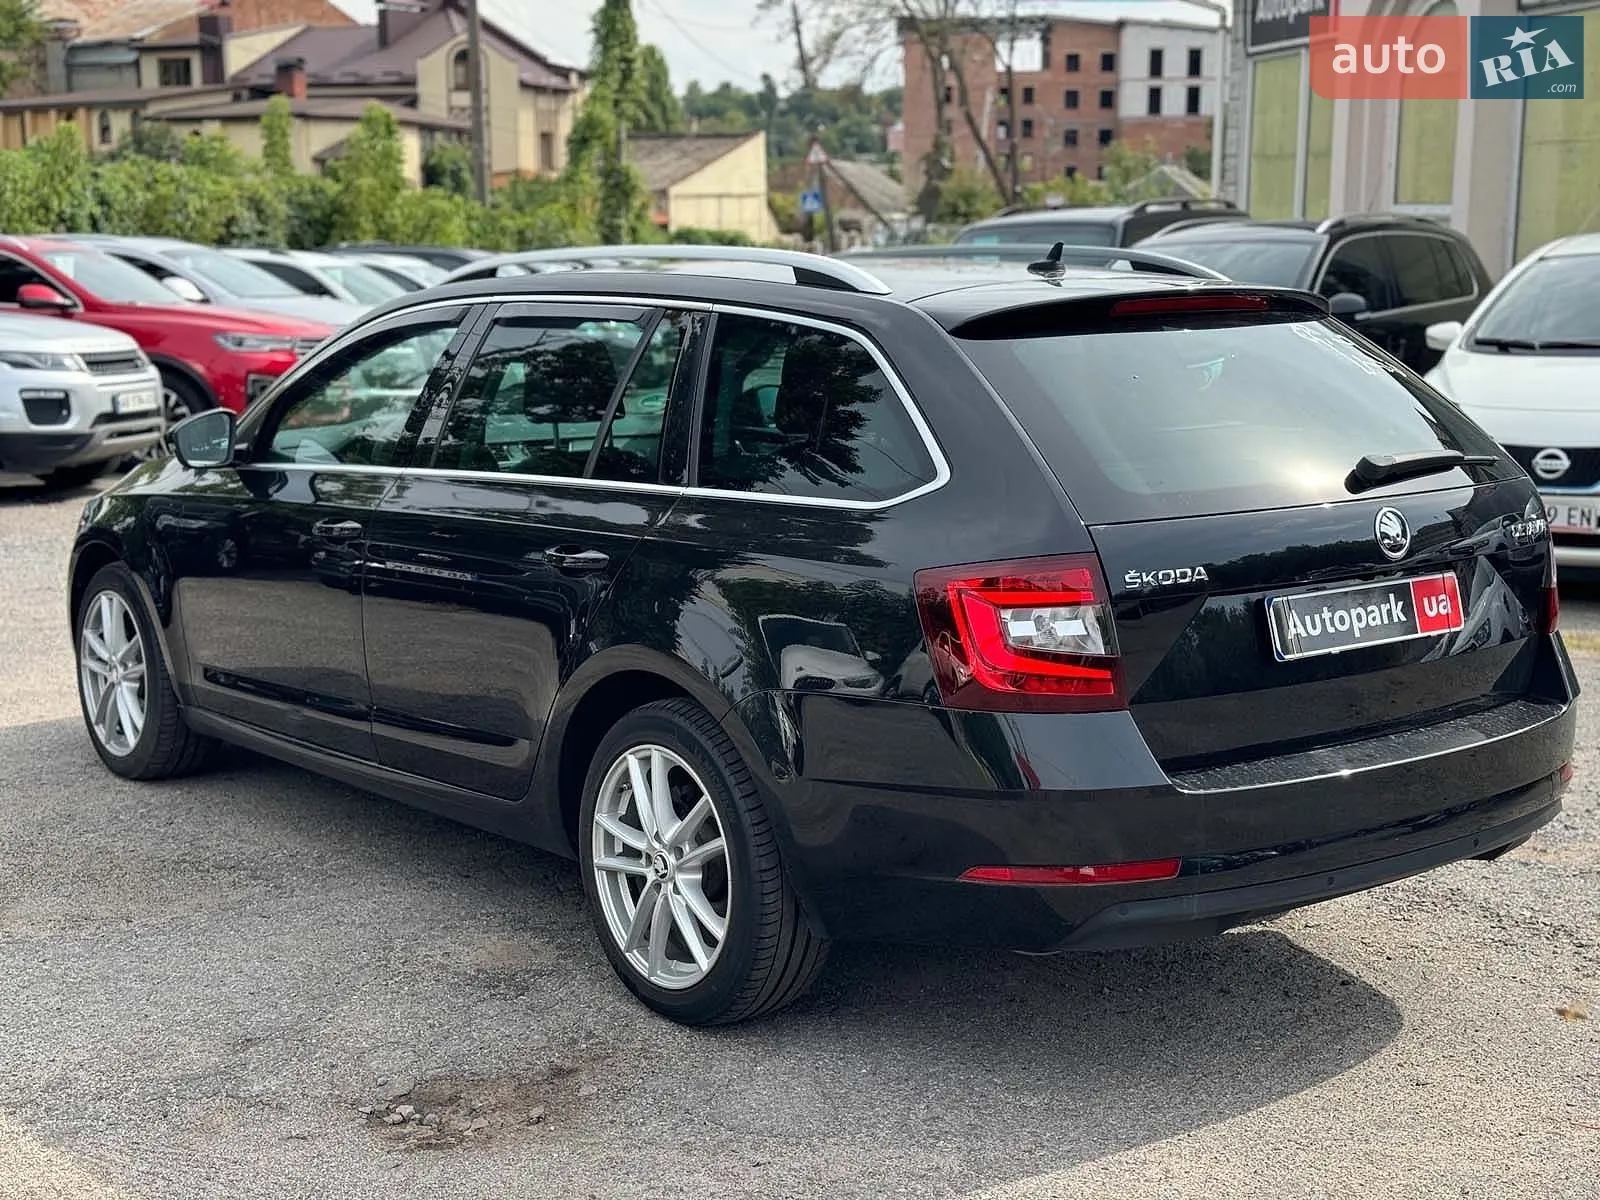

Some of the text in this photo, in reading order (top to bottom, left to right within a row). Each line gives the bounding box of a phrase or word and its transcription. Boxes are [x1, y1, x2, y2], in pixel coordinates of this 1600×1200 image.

[1124, 566, 1209, 589] ŠKODA
[1287, 593, 1452, 640] Autopark ua
